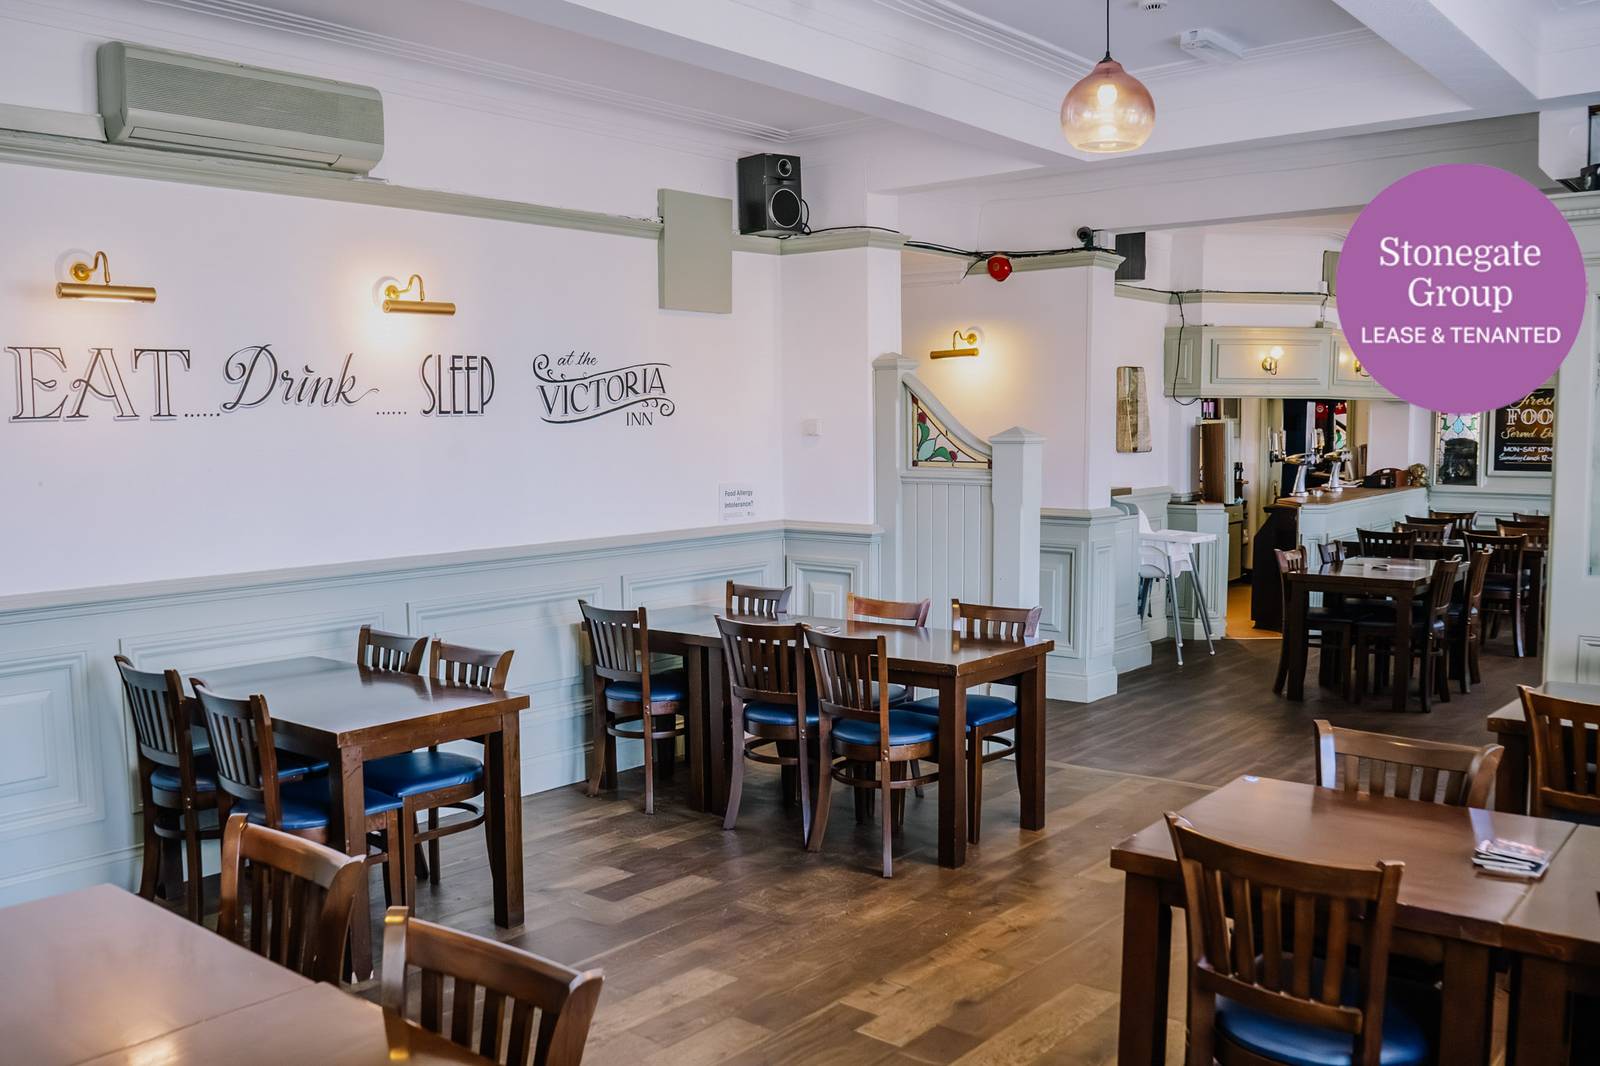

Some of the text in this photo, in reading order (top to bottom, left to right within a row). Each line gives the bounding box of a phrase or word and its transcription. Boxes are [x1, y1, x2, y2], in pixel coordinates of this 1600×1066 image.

[557, 350, 598, 366] at the
[220, 343, 380, 411] Drink
[420, 353, 496, 416] SLEEP
[536, 367, 667, 416] VICTORIA
[626, 412, 654, 427] INN
[1506, 408, 1554, 425] FOO
